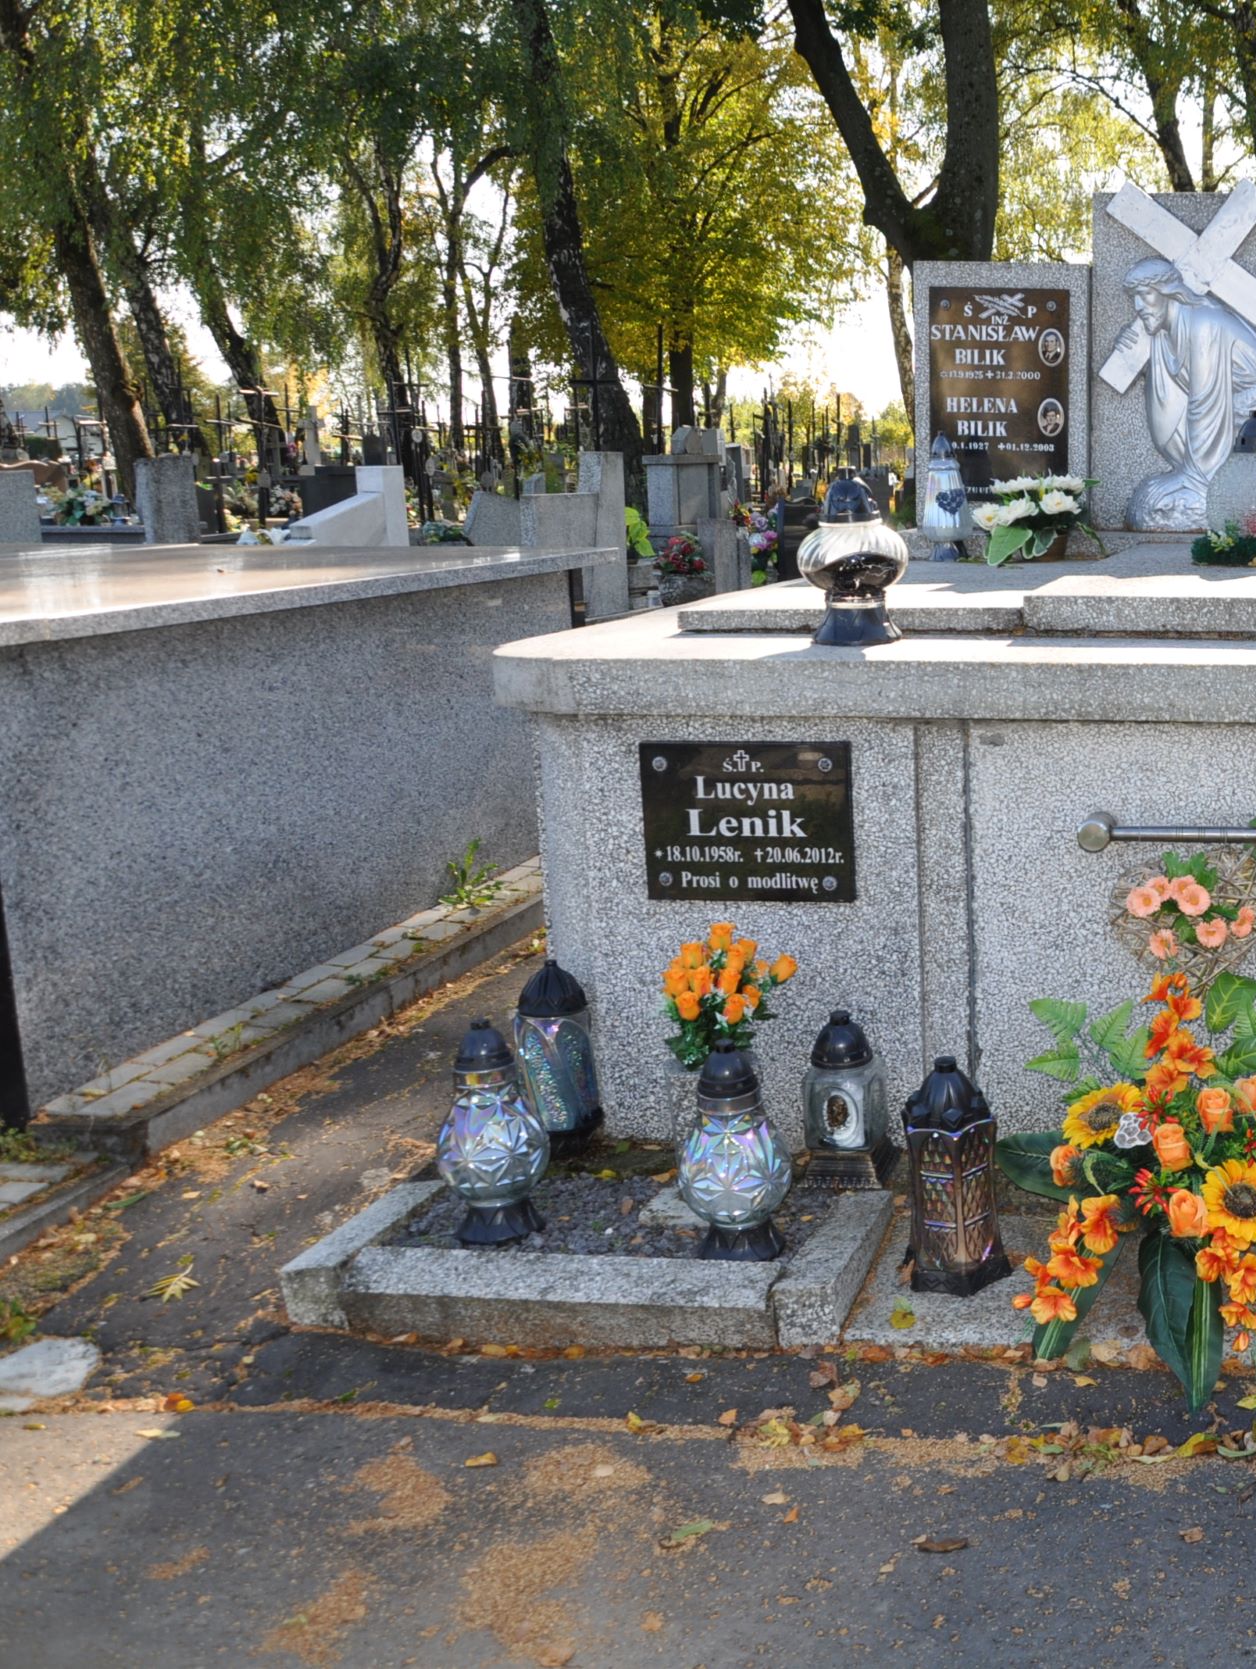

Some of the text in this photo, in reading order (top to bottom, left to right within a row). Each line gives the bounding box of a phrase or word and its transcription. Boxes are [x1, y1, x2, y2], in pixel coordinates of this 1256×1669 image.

[1028, 307, 1037, 318] P
[931, 324, 1039, 342] STANISŁAW
[955, 349, 1006, 365] BILIK
[946, 397, 1018, 414] HELENA
[957, 421, 1008, 437] BILIK
[695, 776, 794, 806] Lucyna
[686, 809, 808, 838] Lenik
[666, 845, 844, 864] 18.10.1958r. 20.06.2012r.
[681, 872, 819, 894] Prosi o modlitwę
